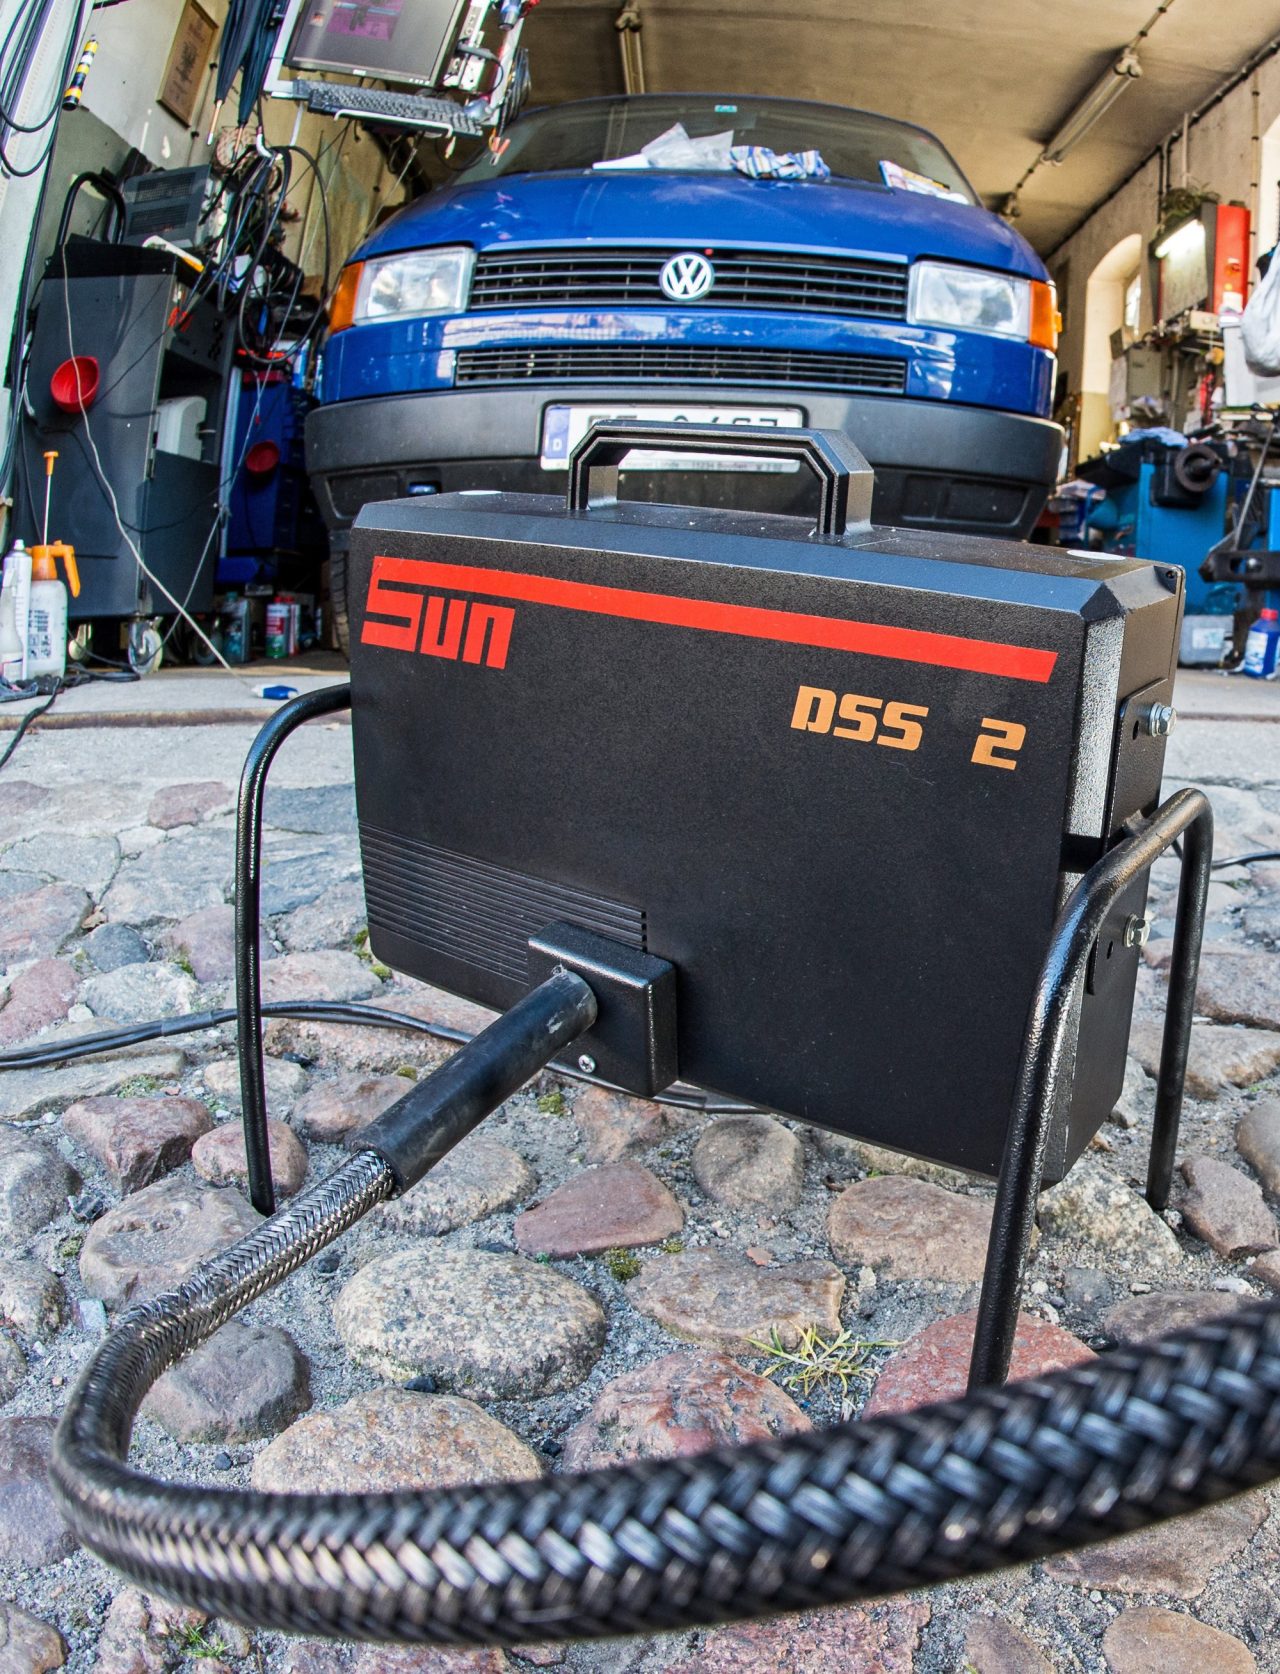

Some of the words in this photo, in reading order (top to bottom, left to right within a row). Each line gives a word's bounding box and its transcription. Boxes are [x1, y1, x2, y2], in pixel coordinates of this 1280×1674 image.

[662, 254, 712, 300] VW
[790, 685, 929, 751] DSS
[970, 717, 1027, 771] 2
